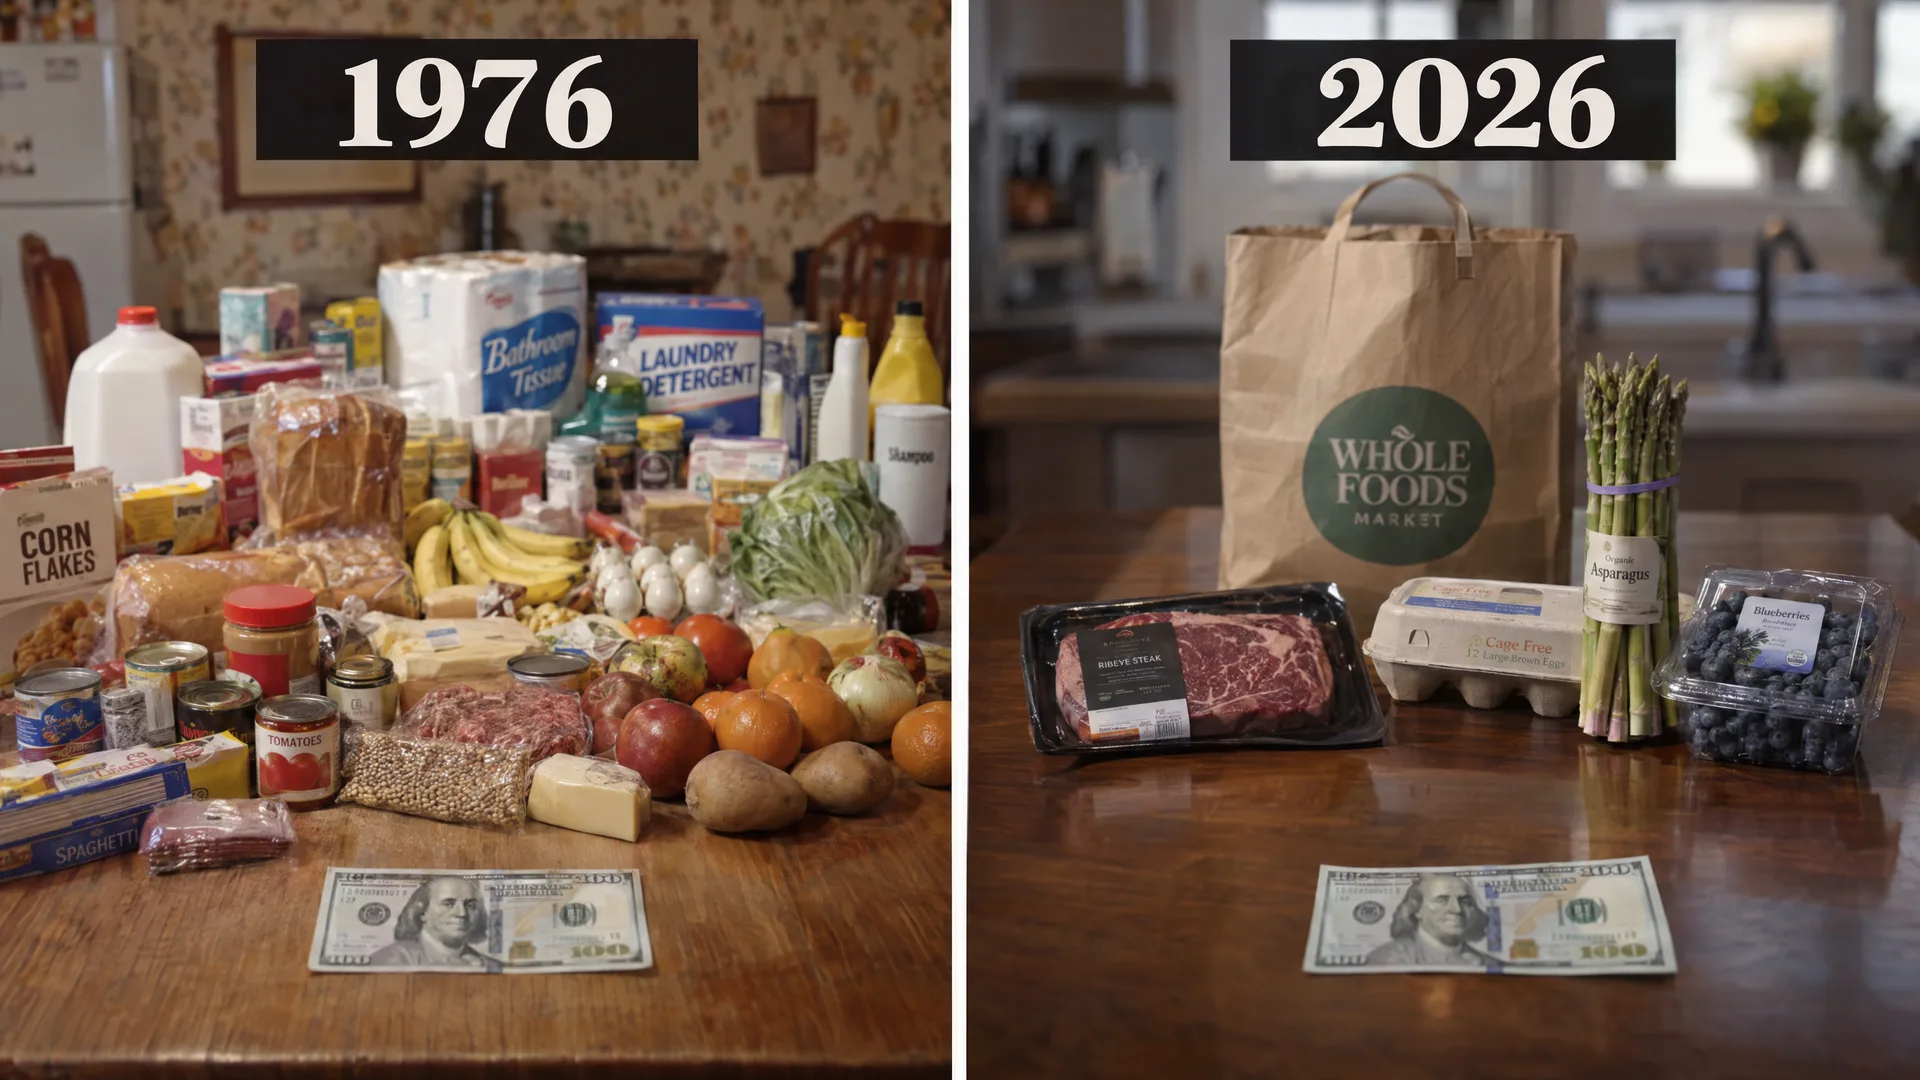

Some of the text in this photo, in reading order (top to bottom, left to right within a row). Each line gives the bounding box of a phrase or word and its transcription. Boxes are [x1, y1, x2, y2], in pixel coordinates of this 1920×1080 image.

[484, 327, 577, 375] Bathroom
[640, 340, 738, 372] LAUNDRY
[509, 361, 567, 398] Tissue
[640, 363, 755, 397] DETERGENT
[1328, 434, 1472, 473] WHOLE
[1336, 472, 1469, 508] FOODS
[1354, 512, 1444, 528] MARKET
[20, 520, 92, 560] CORN
[22, 549, 96, 586] FLAKES
[1604, 554, 1635, 565] Organic
[1590, 562, 1650, 585] Asparagus
[1753, 606, 1811, 621] Blueberries
[1485, 636, 1554, 655] Cage Free
[1098, 654, 1162, 669] RIBEYE STEAK
[1466, 648, 1566, 670] 12 Large Brown Eggs
[268, 734, 322, 748] TOMATOES
[56, 828, 139, 865] SPAGHETTI
[571, 944, 630, 958] 100
[1580, 944, 1648, 959] 100
